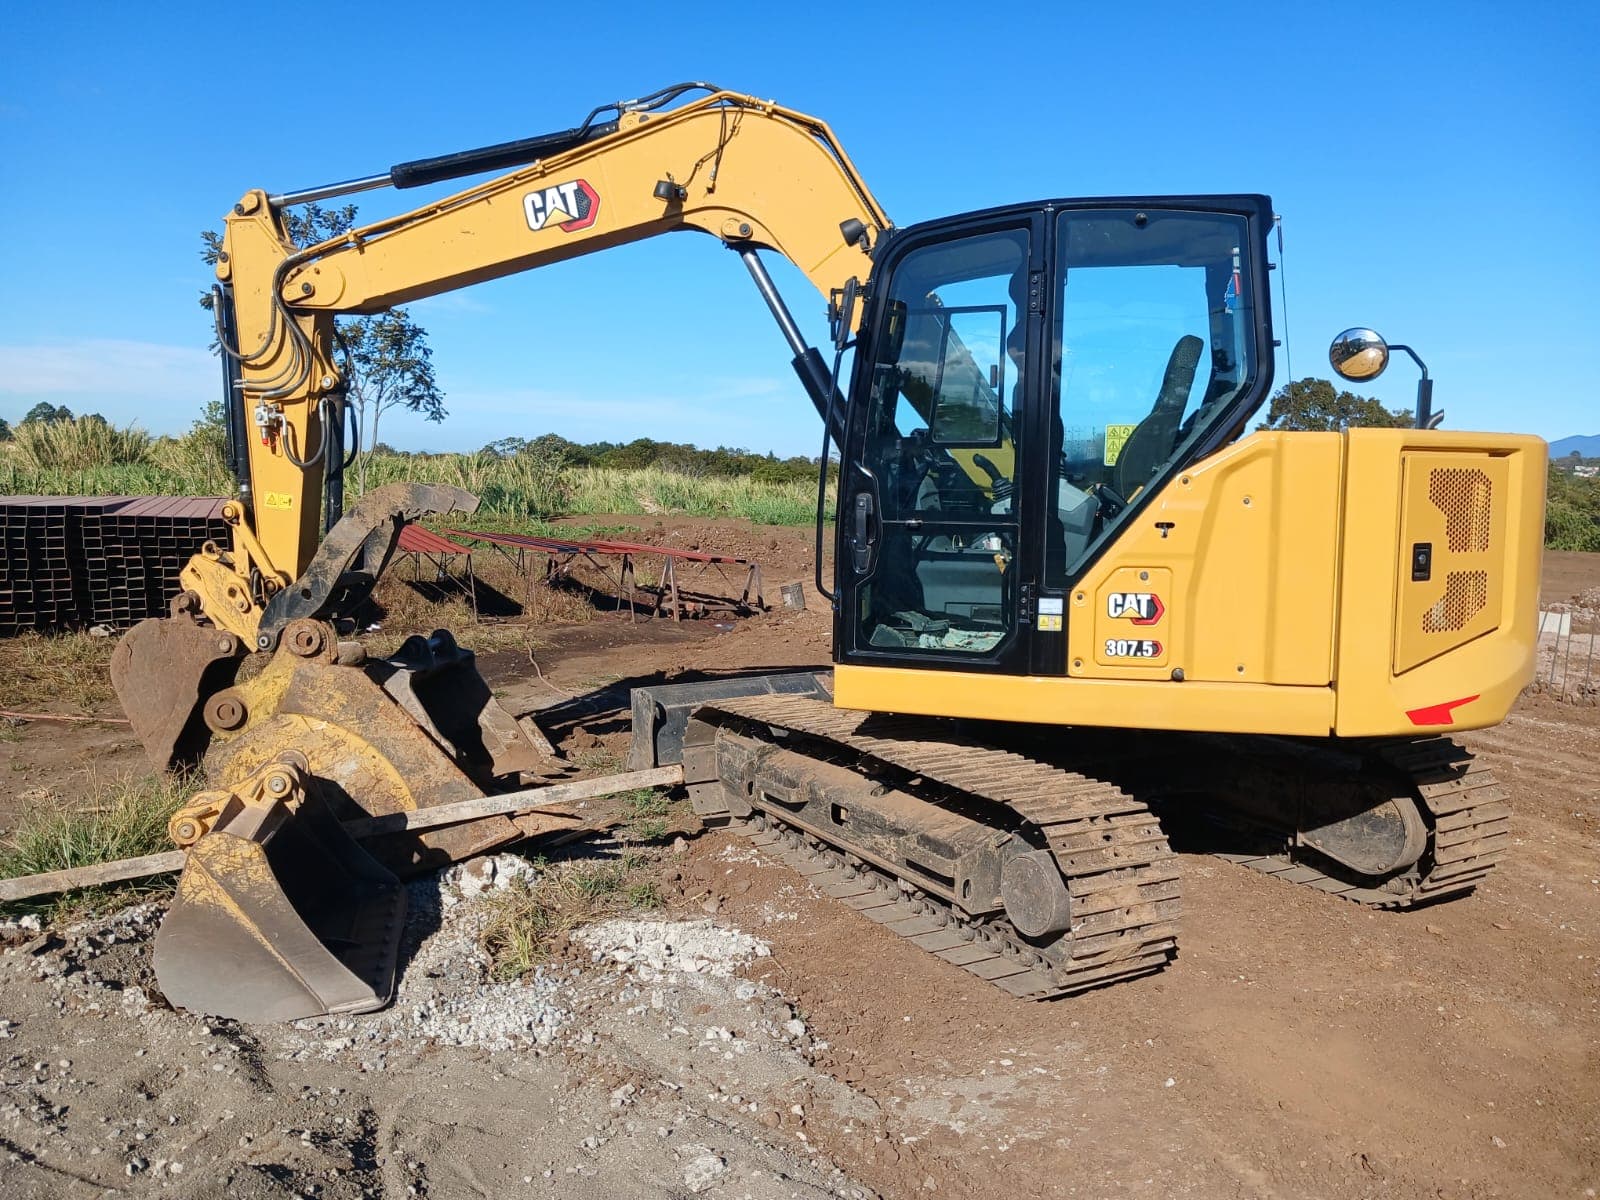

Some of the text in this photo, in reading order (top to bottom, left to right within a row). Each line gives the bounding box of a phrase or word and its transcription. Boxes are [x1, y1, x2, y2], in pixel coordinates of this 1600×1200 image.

[523, 181, 580, 231] CAT
[1108, 593, 1152, 618] CAT
[1105, 639, 1153, 657] 307.5
